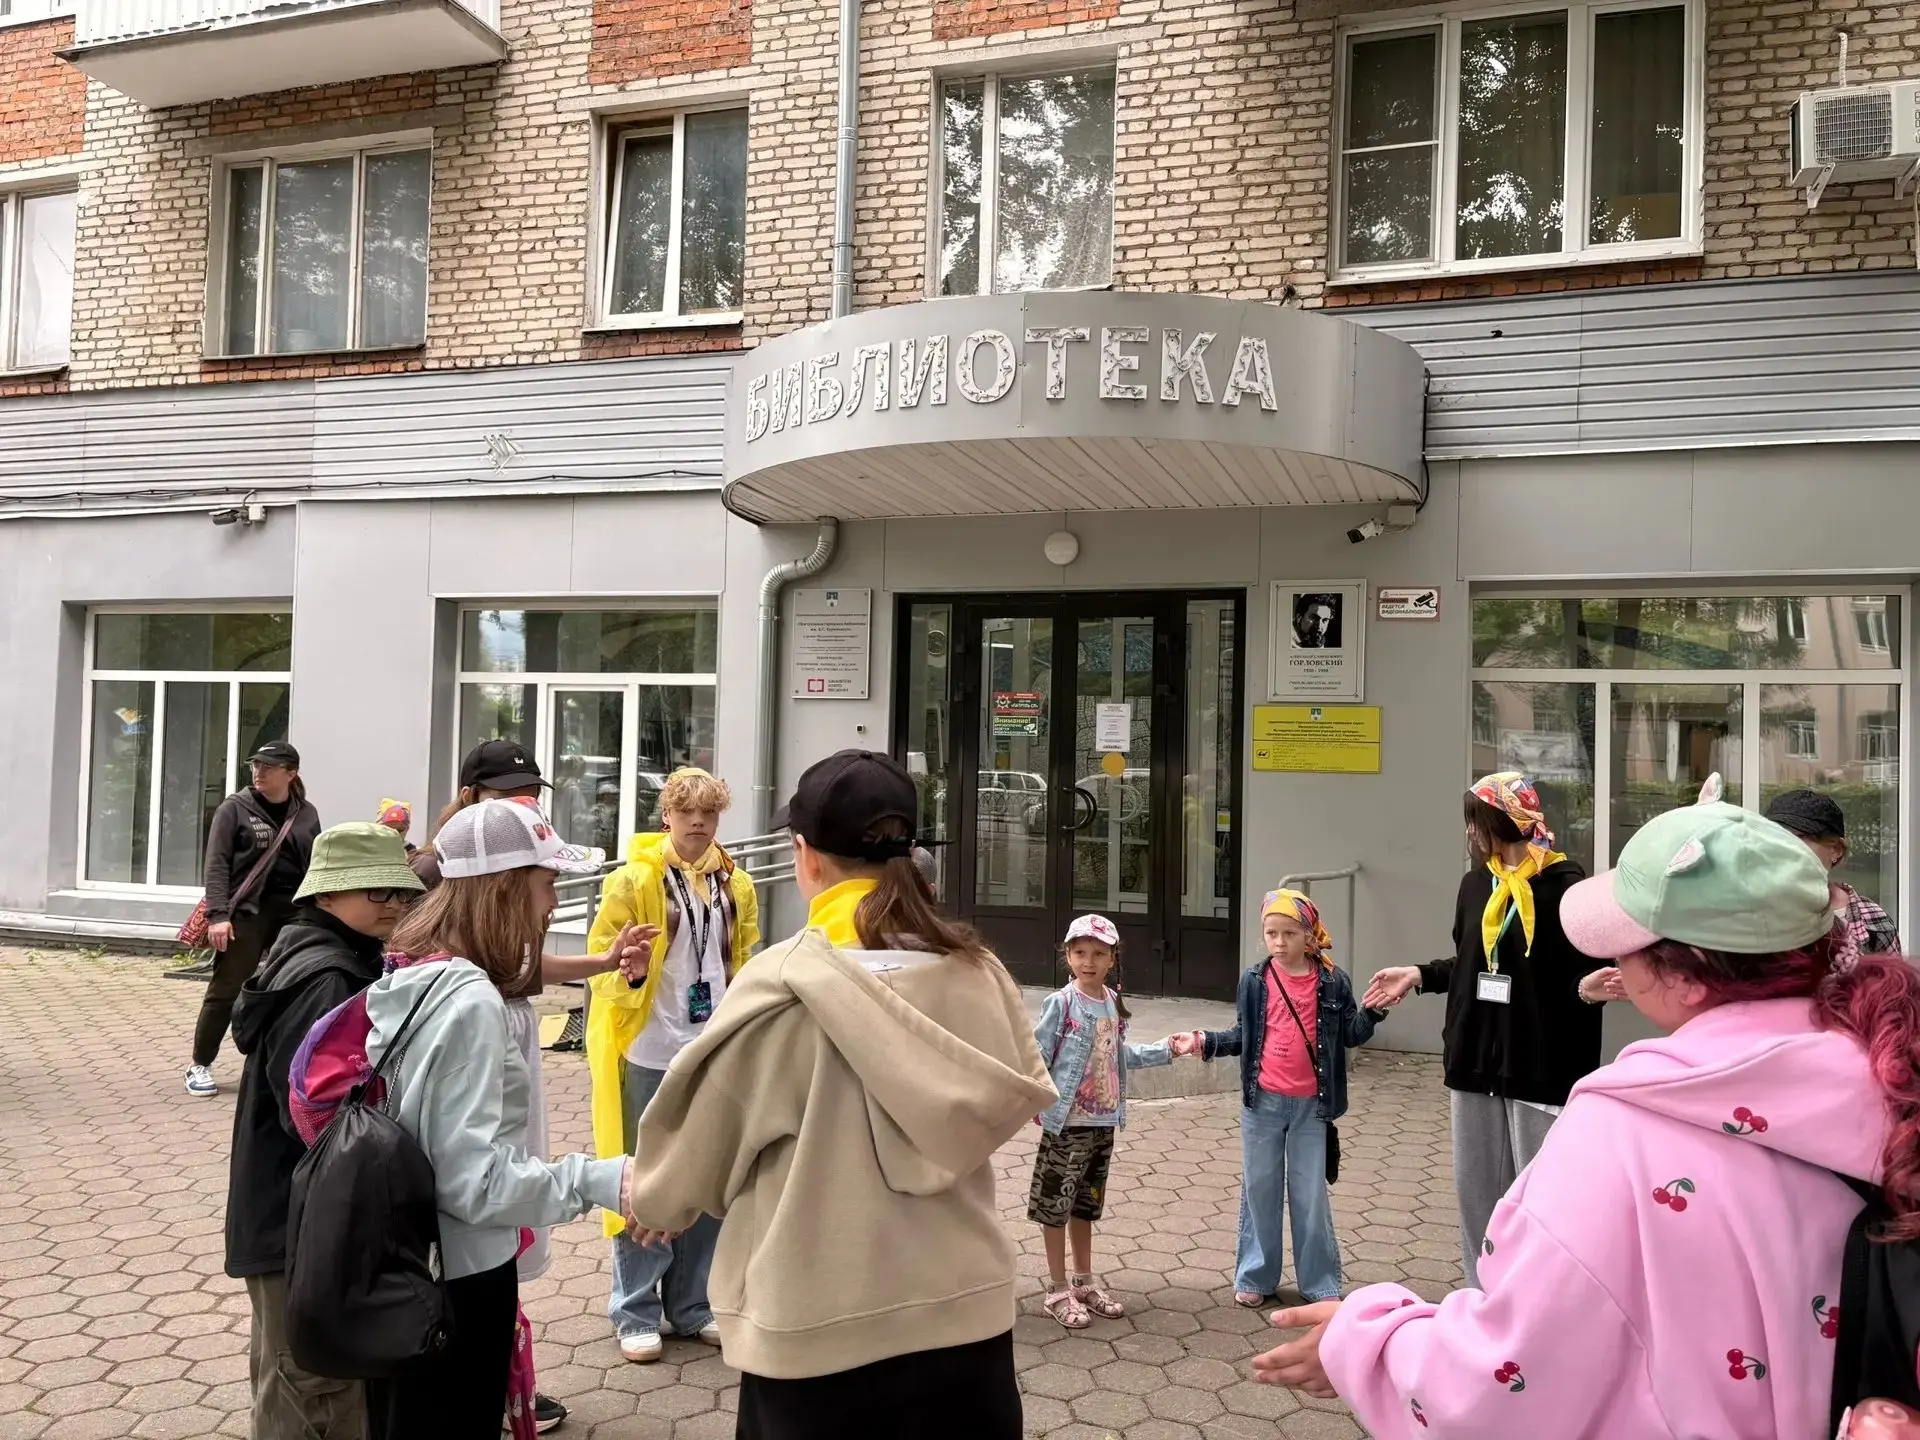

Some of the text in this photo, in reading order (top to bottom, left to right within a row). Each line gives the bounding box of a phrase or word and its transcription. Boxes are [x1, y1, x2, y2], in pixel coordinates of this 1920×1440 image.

[745, 326, 1279, 443] БИБЛИОТЕКА
[1289, 658, 1343, 667] ГОРЛОВСКИЙ
[255, 831, 268, 839] TWO
[1056, 1151, 1087, 1211] Likee
